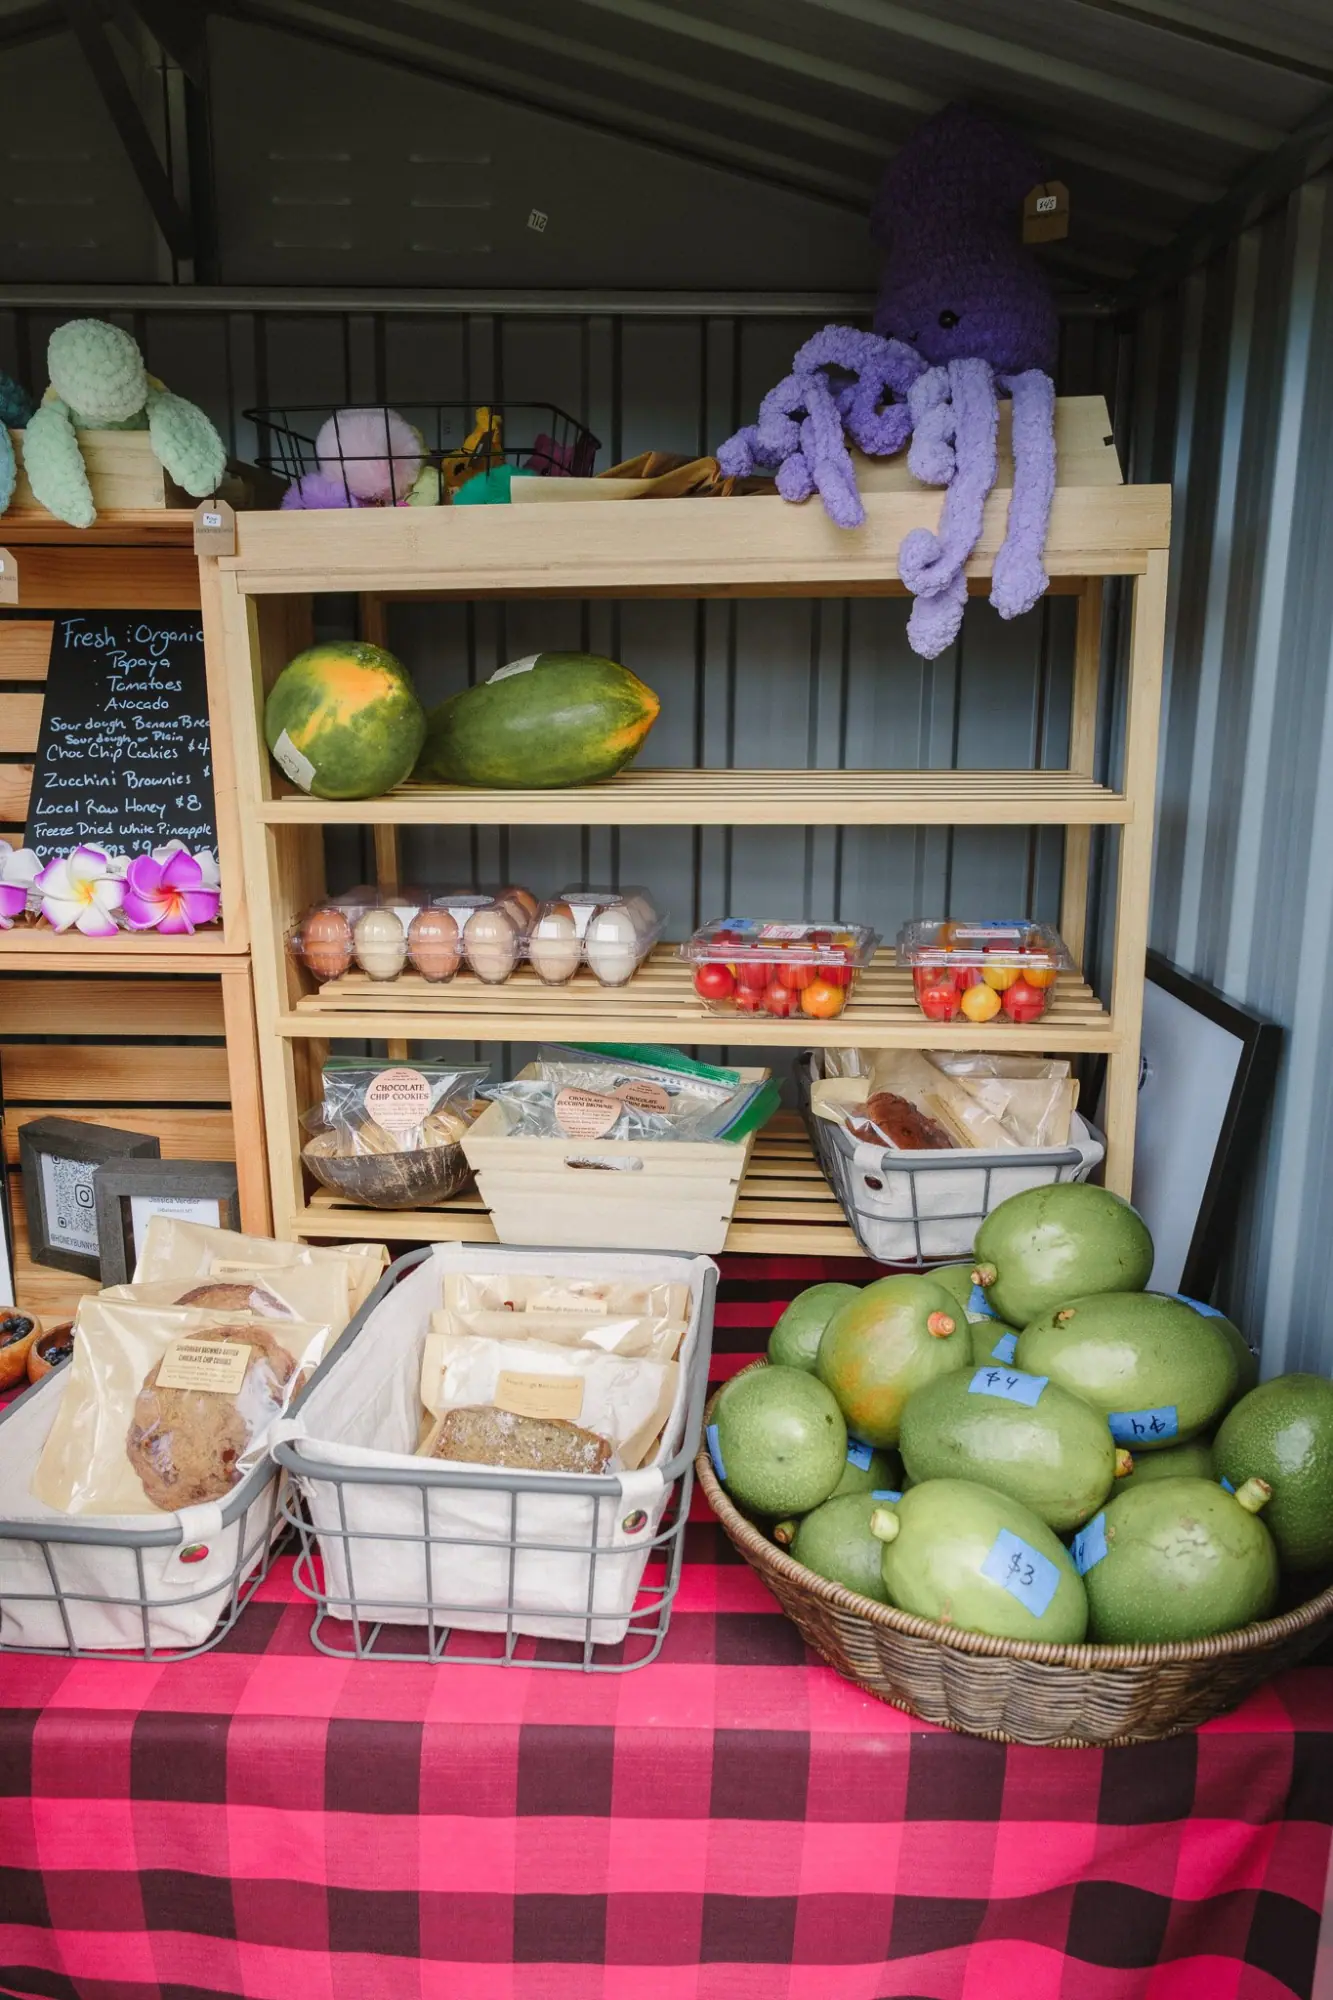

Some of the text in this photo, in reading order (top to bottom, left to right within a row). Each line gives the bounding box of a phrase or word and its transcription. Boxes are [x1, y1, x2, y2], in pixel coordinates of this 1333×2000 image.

[61, 618, 117, 649] Fresh
[105, 650, 171, 678] Papaya
[106, 675, 183, 692] Tomatoes
[103, 696, 170, 712] Avocado
[131, 715, 179, 730] Banana
[151, 730, 184, 742] Plain
[46, 743, 85, 762] Choc
[88, 742, 122, 763] Chip
[127, 741, 179, 760] Cookies
[43, 770, 117, 788] Zucchini
[121, 770, 192, 789] Brownies
[35, 794, 202, 819] Local Raw Honey $8
[33, 820, 213, 840] Freeze Dried White Pineapple
[370, 1093, 429, 1101] CHIP COOKIES
[375, 1084, 425, 1092] CHOCOLATE
[568, 1095, 603, 1103] CHOCOLATE
[625, 1094, 658, 1105] CHOCOLATE
[986, 1370, 1019, 1390] $4
[1006, 1552, 1035, 1586] $3
